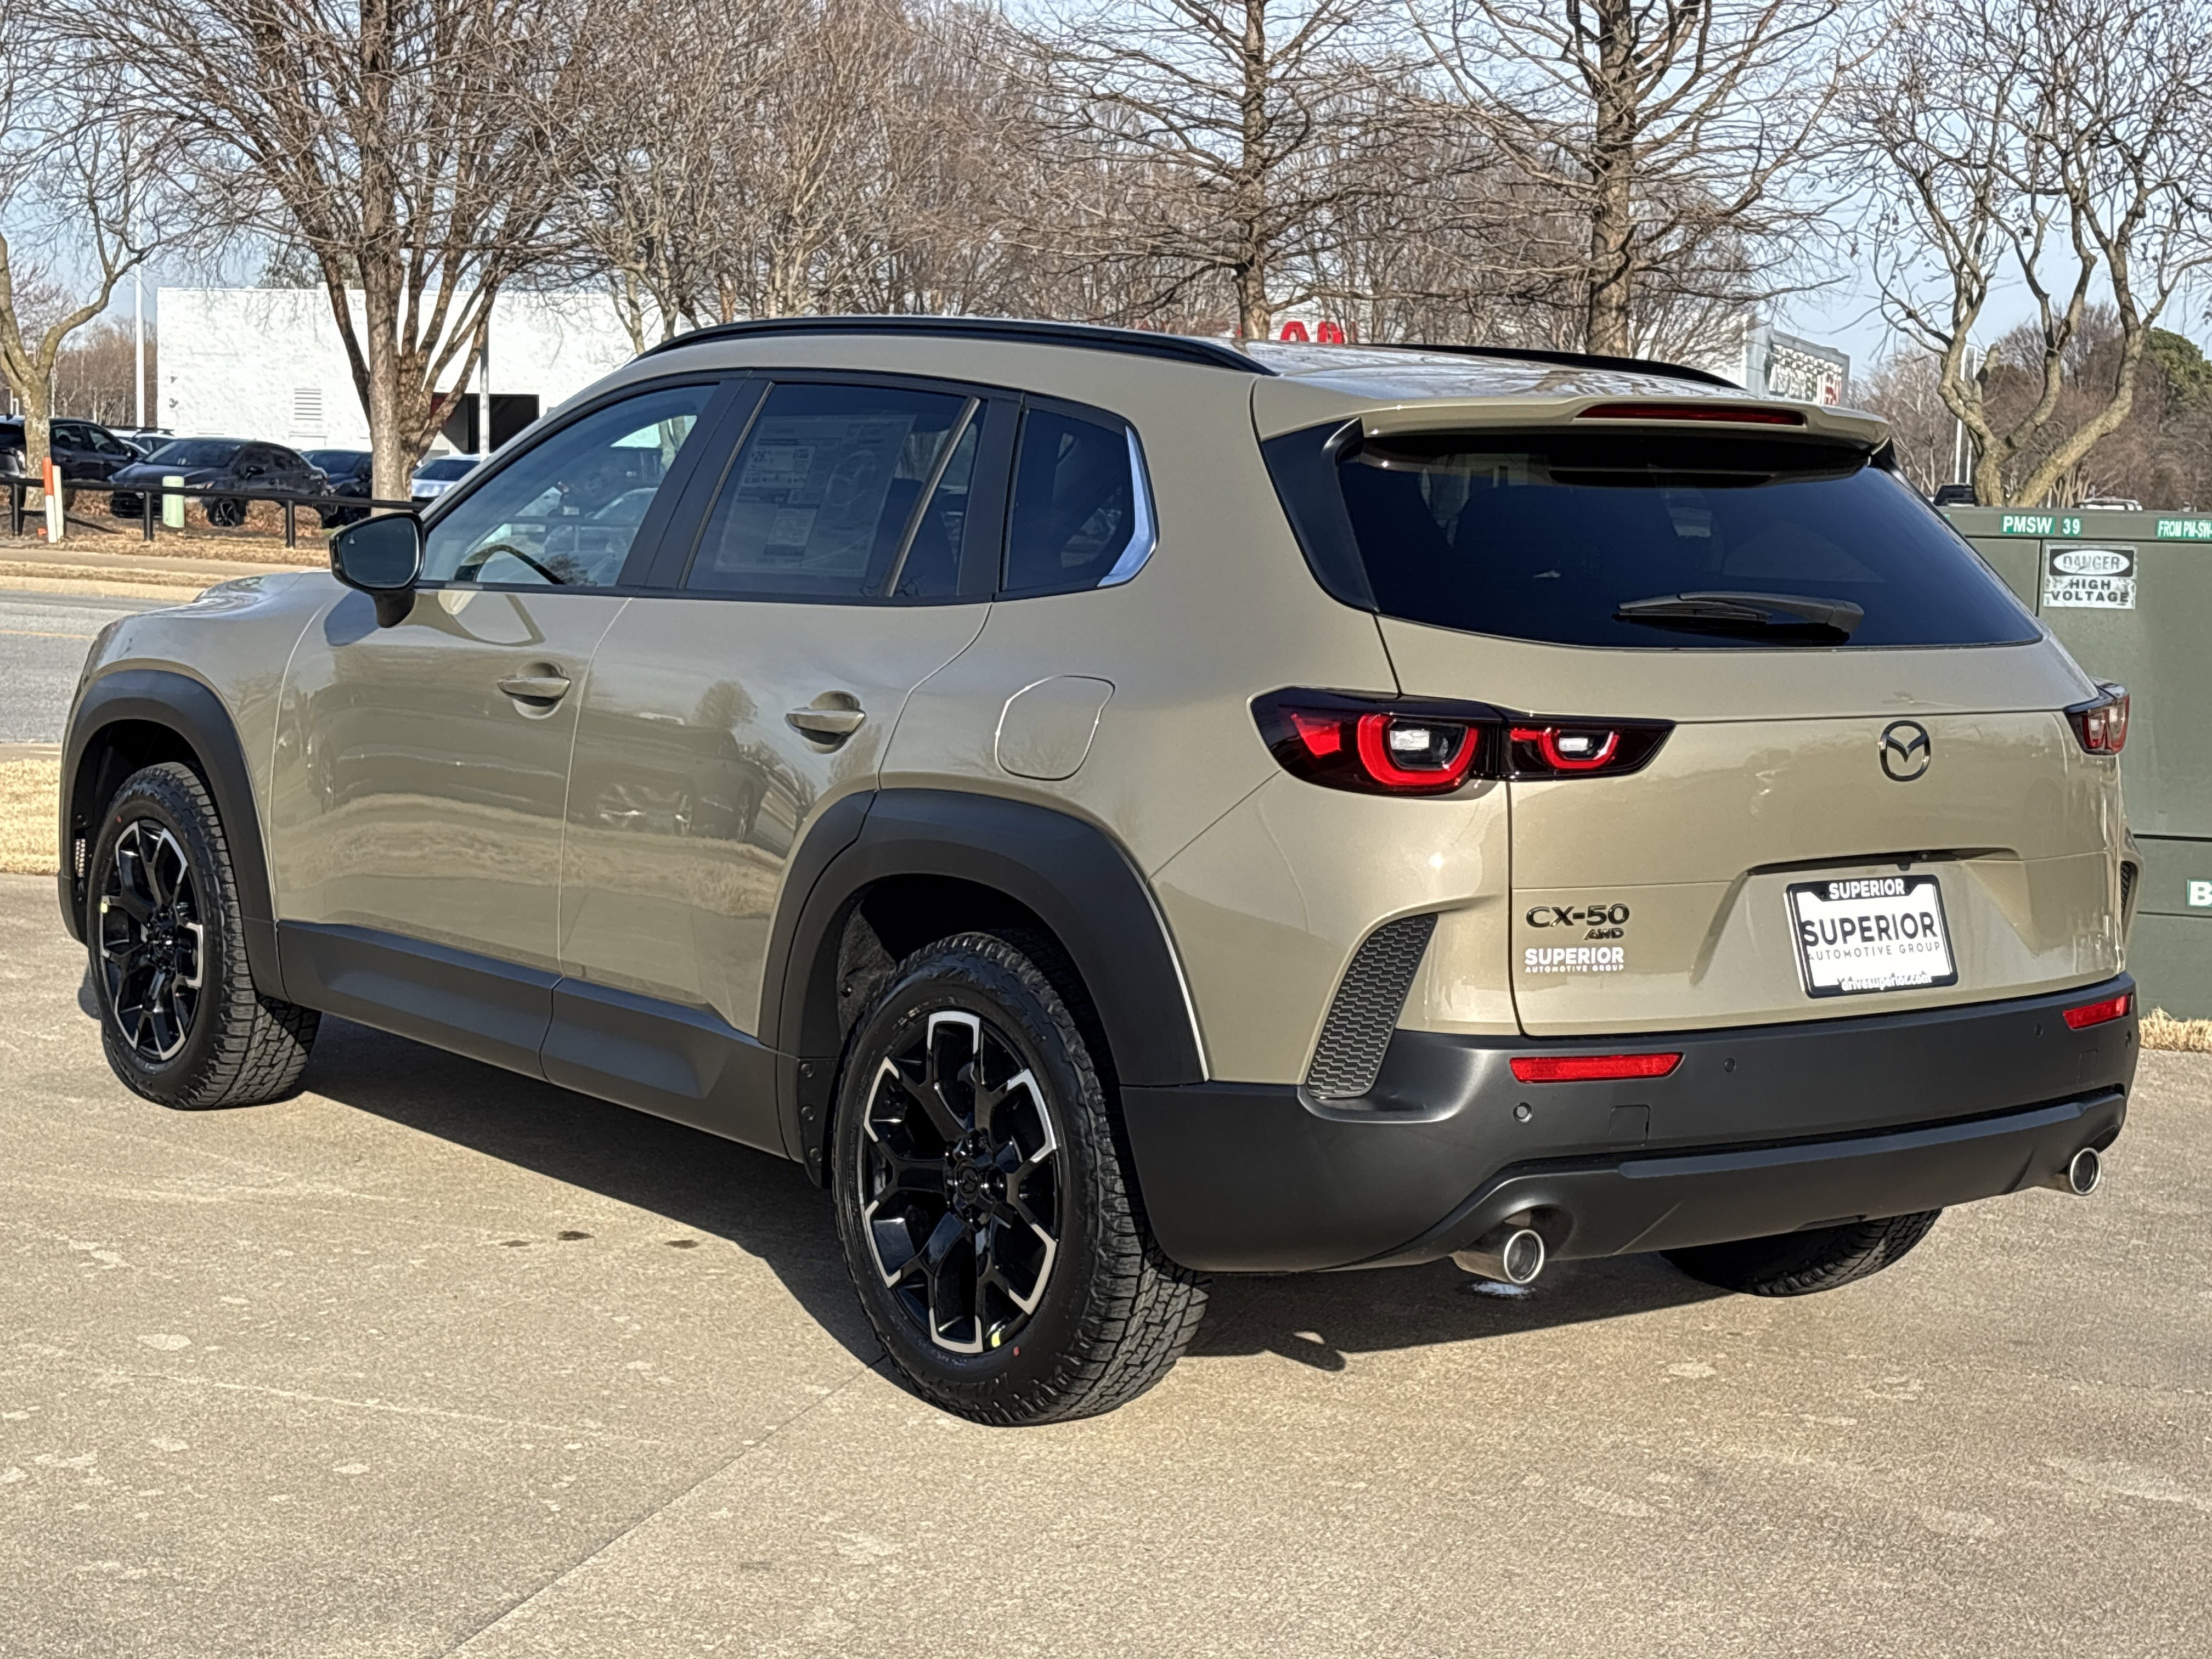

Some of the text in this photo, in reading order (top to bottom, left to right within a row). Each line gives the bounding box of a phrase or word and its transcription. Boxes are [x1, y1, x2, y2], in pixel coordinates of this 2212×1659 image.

[2003, 516, 2080, 535] PMSW 39
[2158, 520, 2182, 537] FROM
[2063, 555, 2120, 569] DANGER
[2069, 579, 2111, 590] HIGH
[2051, 590, 2129, 602] VOLTAGE
[1829, 878, 1905, 899] SUPERIOR
[1526, 903, 1630, 928] CX-50
[1583, 928, 1624, 940] AWD
[1800, 912, 1938, 947] SUPERIOR
[1525, 947, 1624, 965] SUPERIOR
[1808, 941, 1940, 961] AUTOMOTIVE GROUP
[1525, 963, 1624, 974] AUTOMOTIVE GROUP
